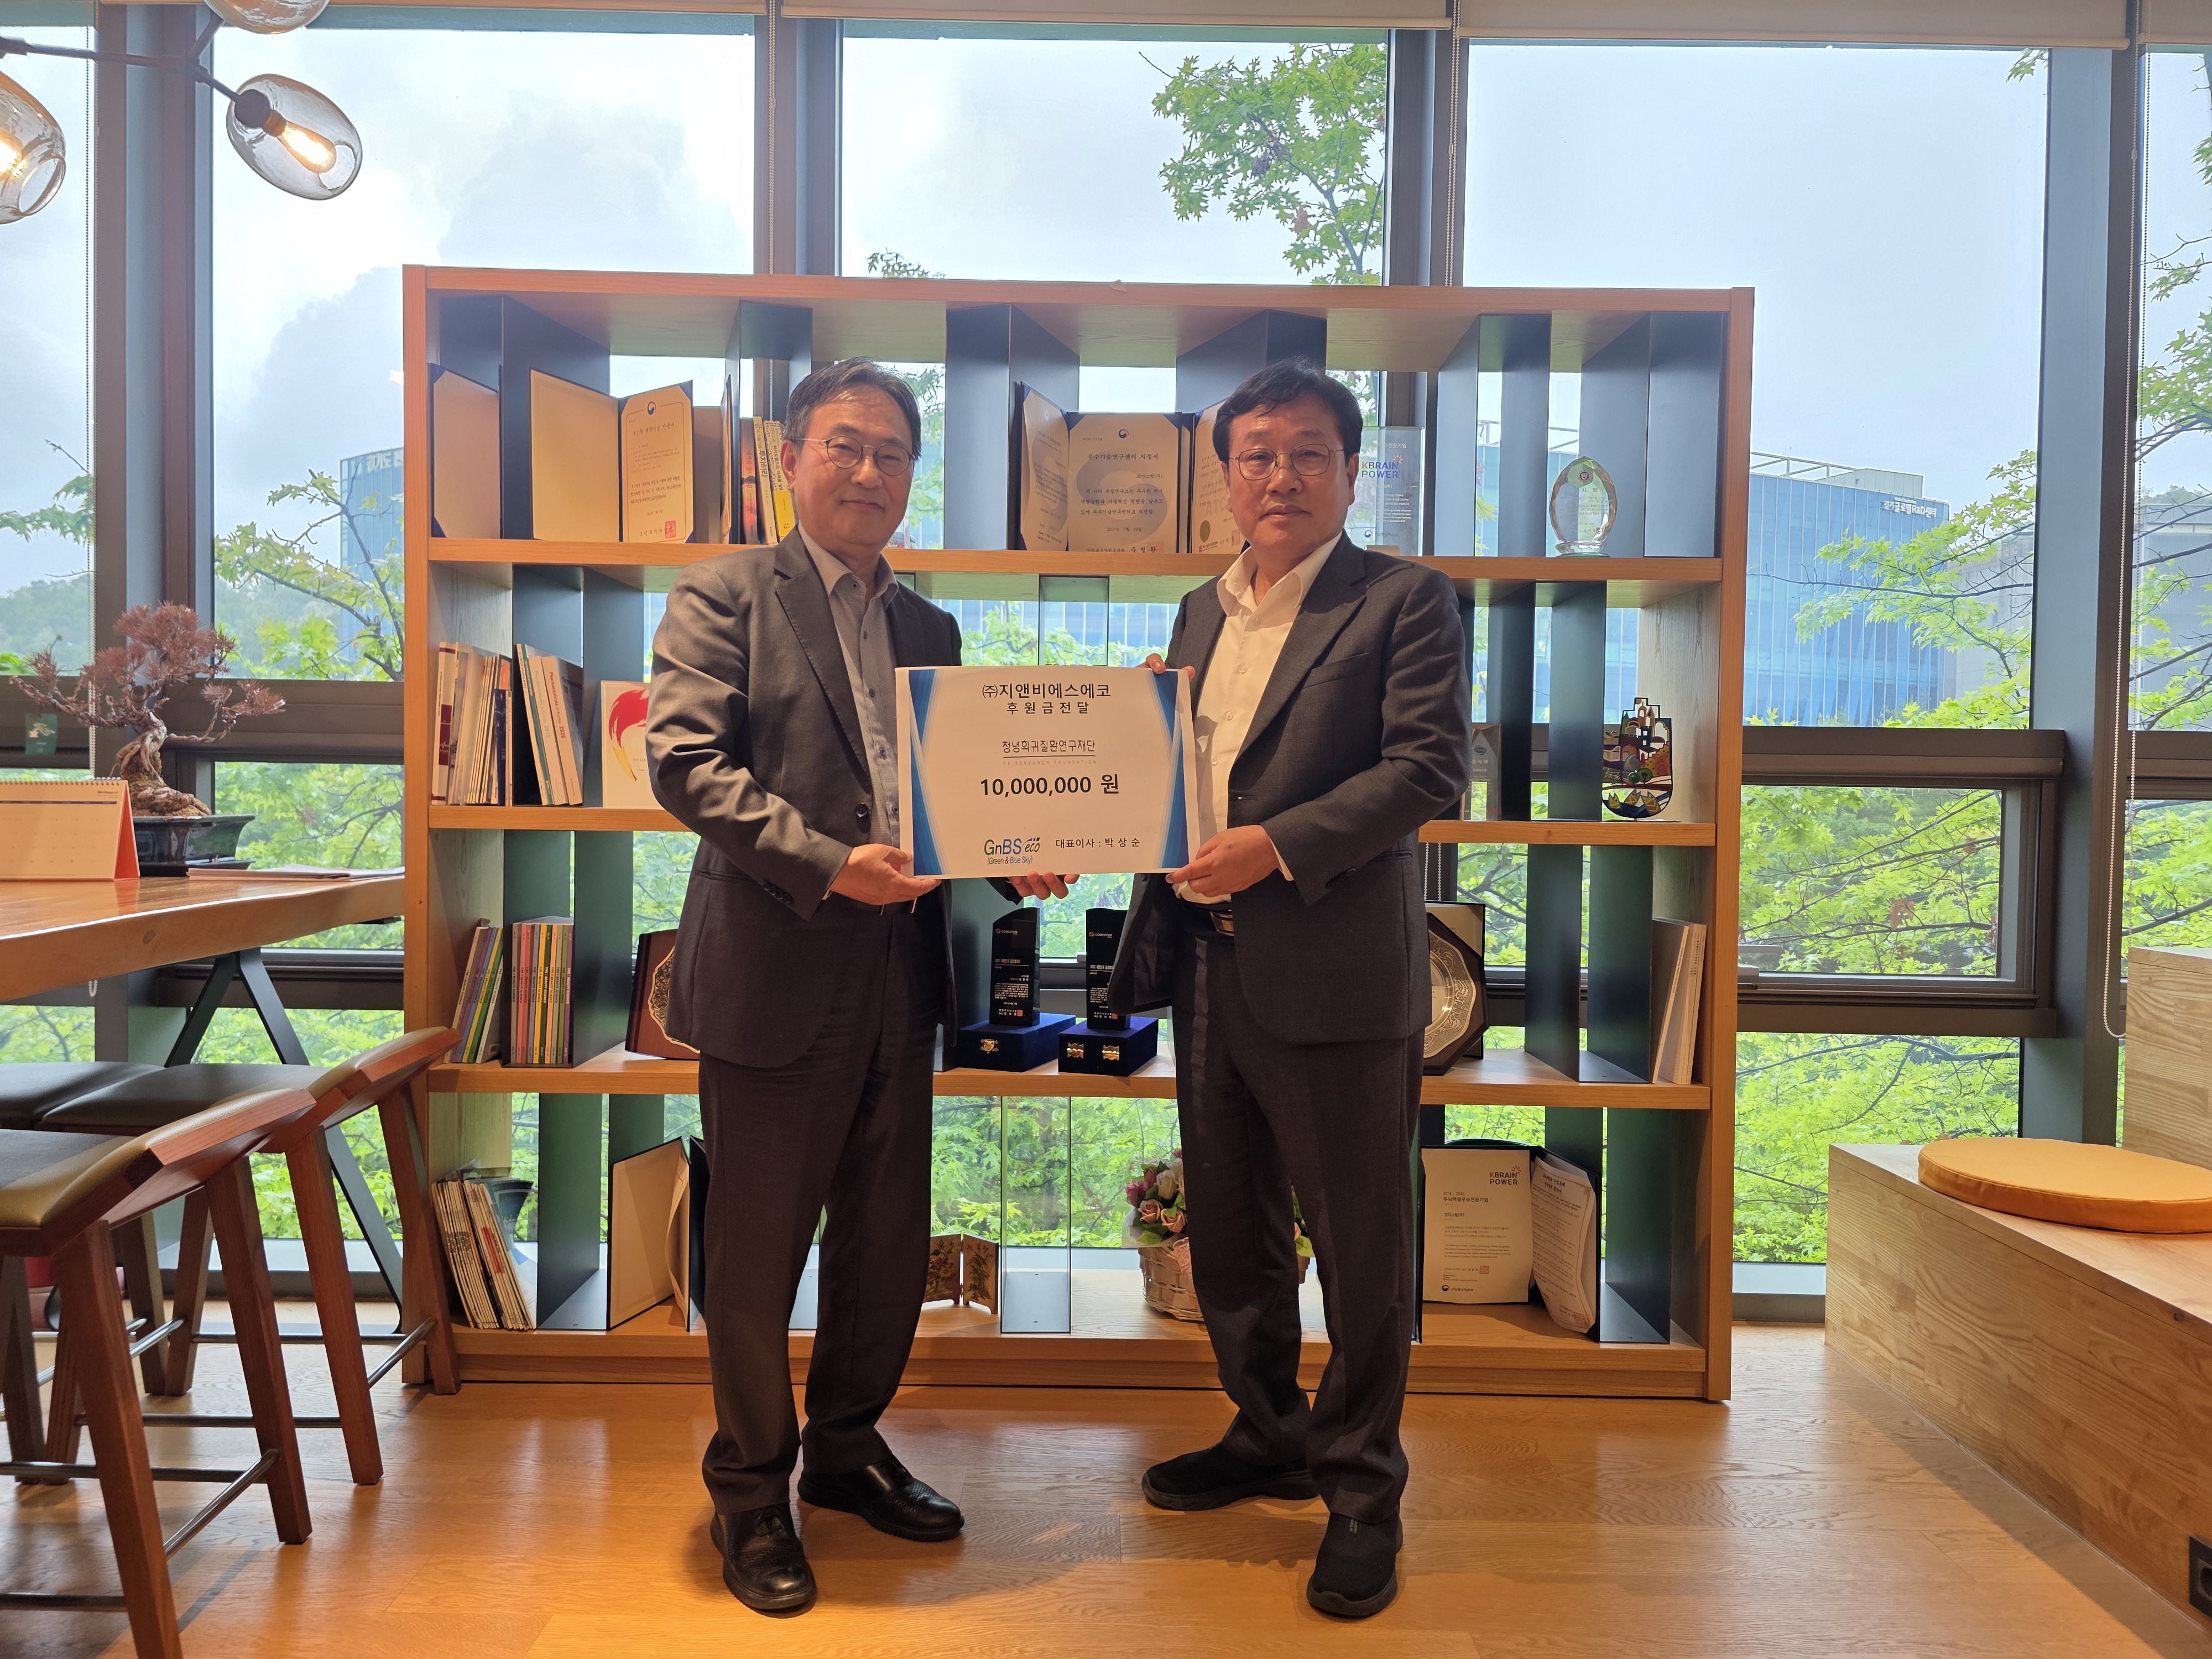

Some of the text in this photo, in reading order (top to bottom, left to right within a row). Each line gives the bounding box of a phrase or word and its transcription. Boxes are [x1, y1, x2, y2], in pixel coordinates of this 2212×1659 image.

[758, 449, 768, 477] 투자하라
[549, 672, 559, 706] Pharmaceuticals
[1002, 740, 1095, 753] 청녕희귀질환연구재단
[980, 774, 1119, 797] 10,000,000 원
[984, 838, 1022, 855] GnBS
[1056, 838, 1095, 849] 대표이사
[987, 857, 1004, 865] (Green
[1021, 855, 1033, 864] Sky)
